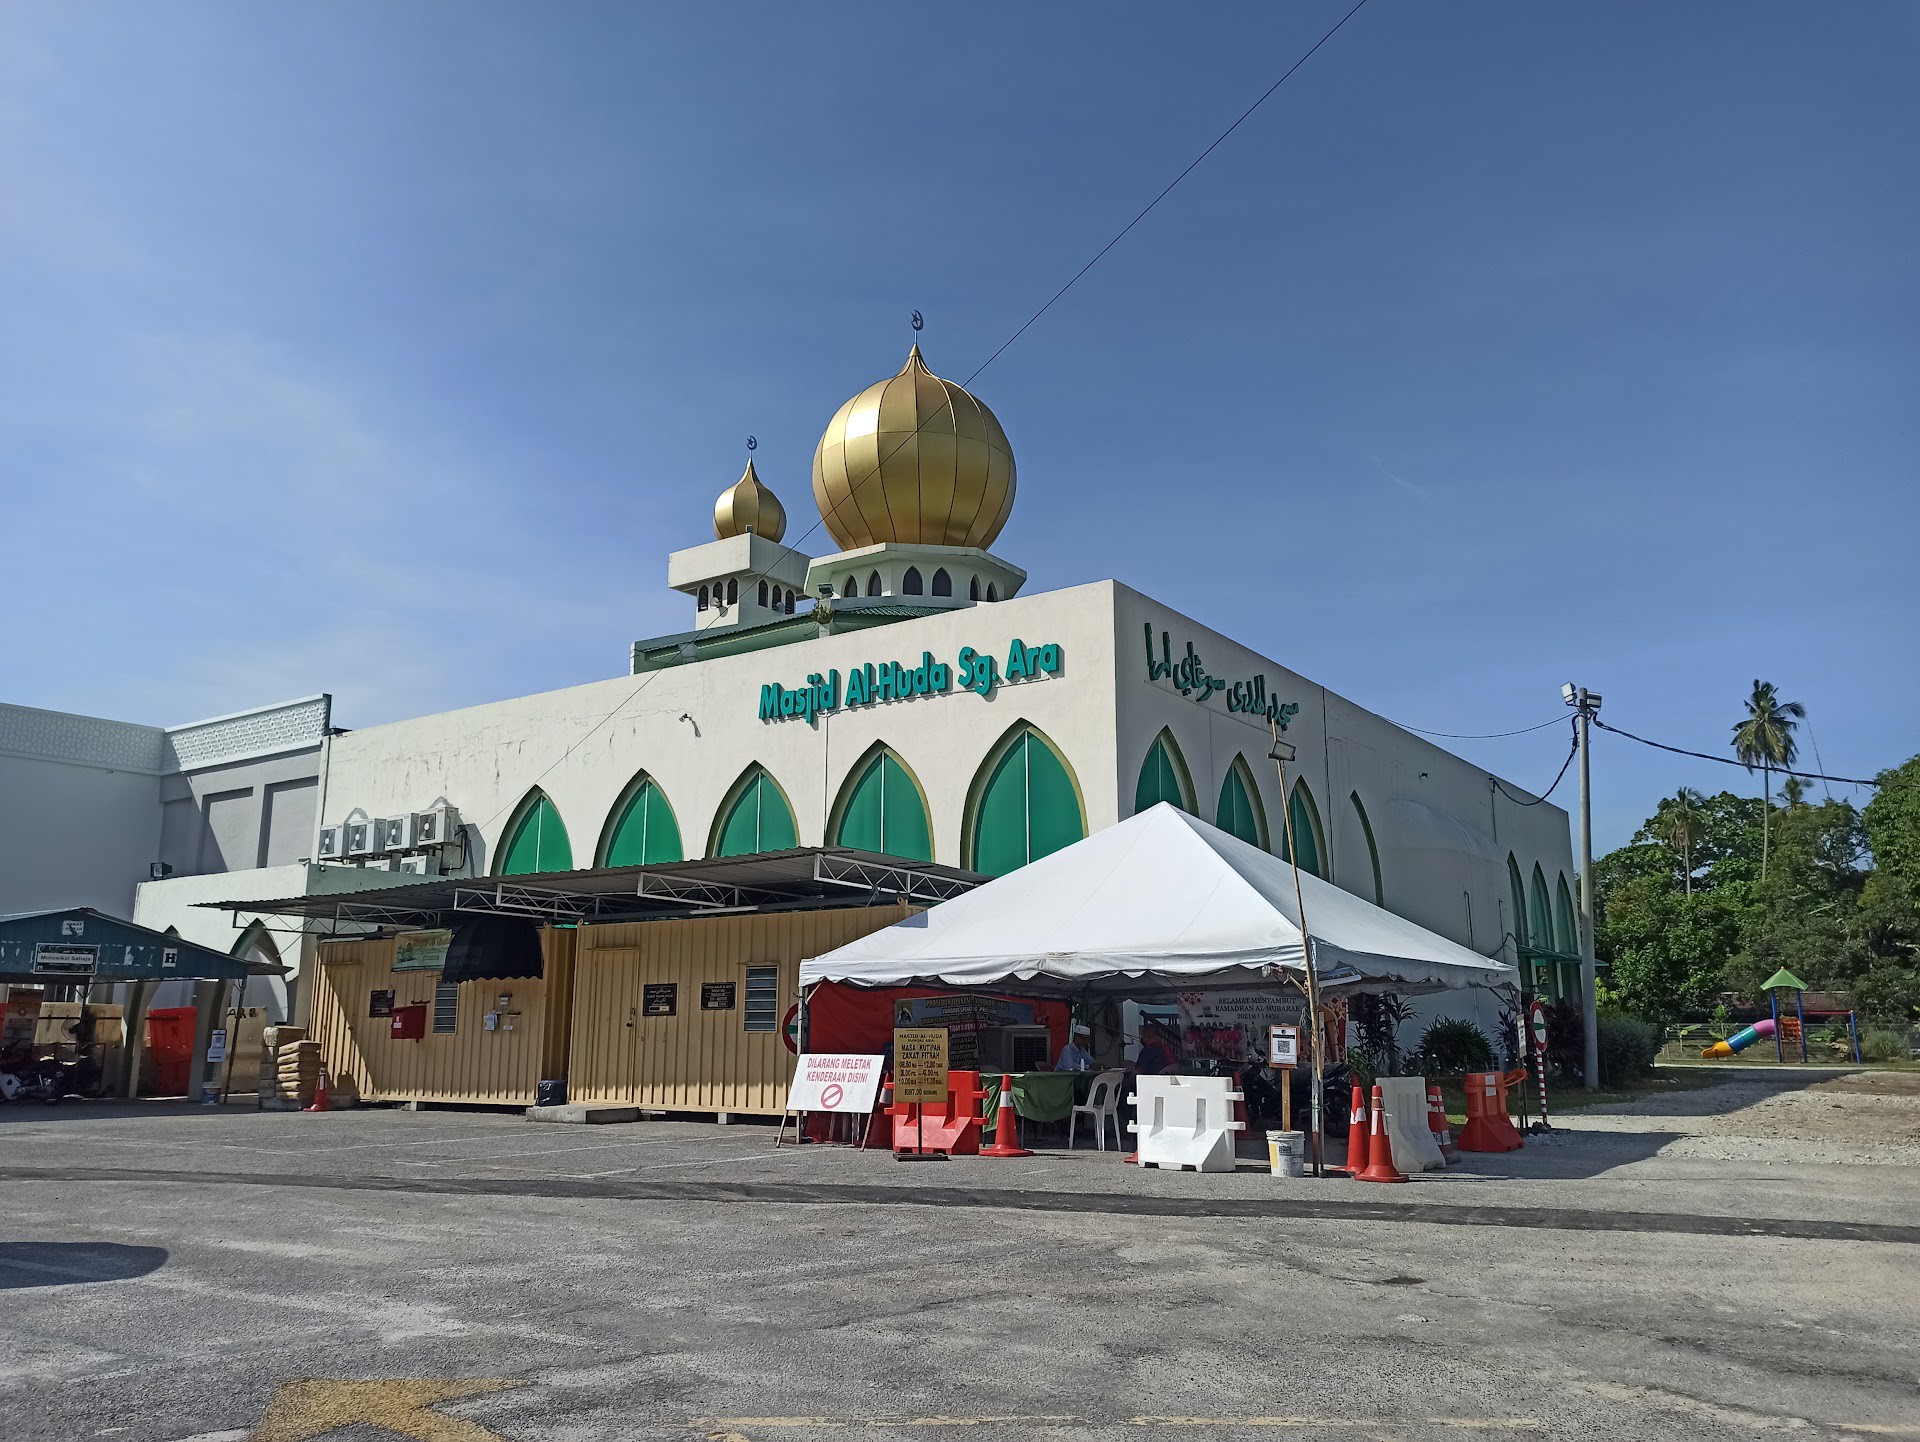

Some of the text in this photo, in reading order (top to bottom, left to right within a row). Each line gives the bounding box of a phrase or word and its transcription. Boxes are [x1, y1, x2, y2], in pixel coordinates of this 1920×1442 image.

[758, 638, 1061, 724] Masjid Al-Huda Sg. Ara
[807, 1058, 872, 1070] DILARANG MELETAK
[806, 1071, 869, 1083] KENDERAAN DISINI
